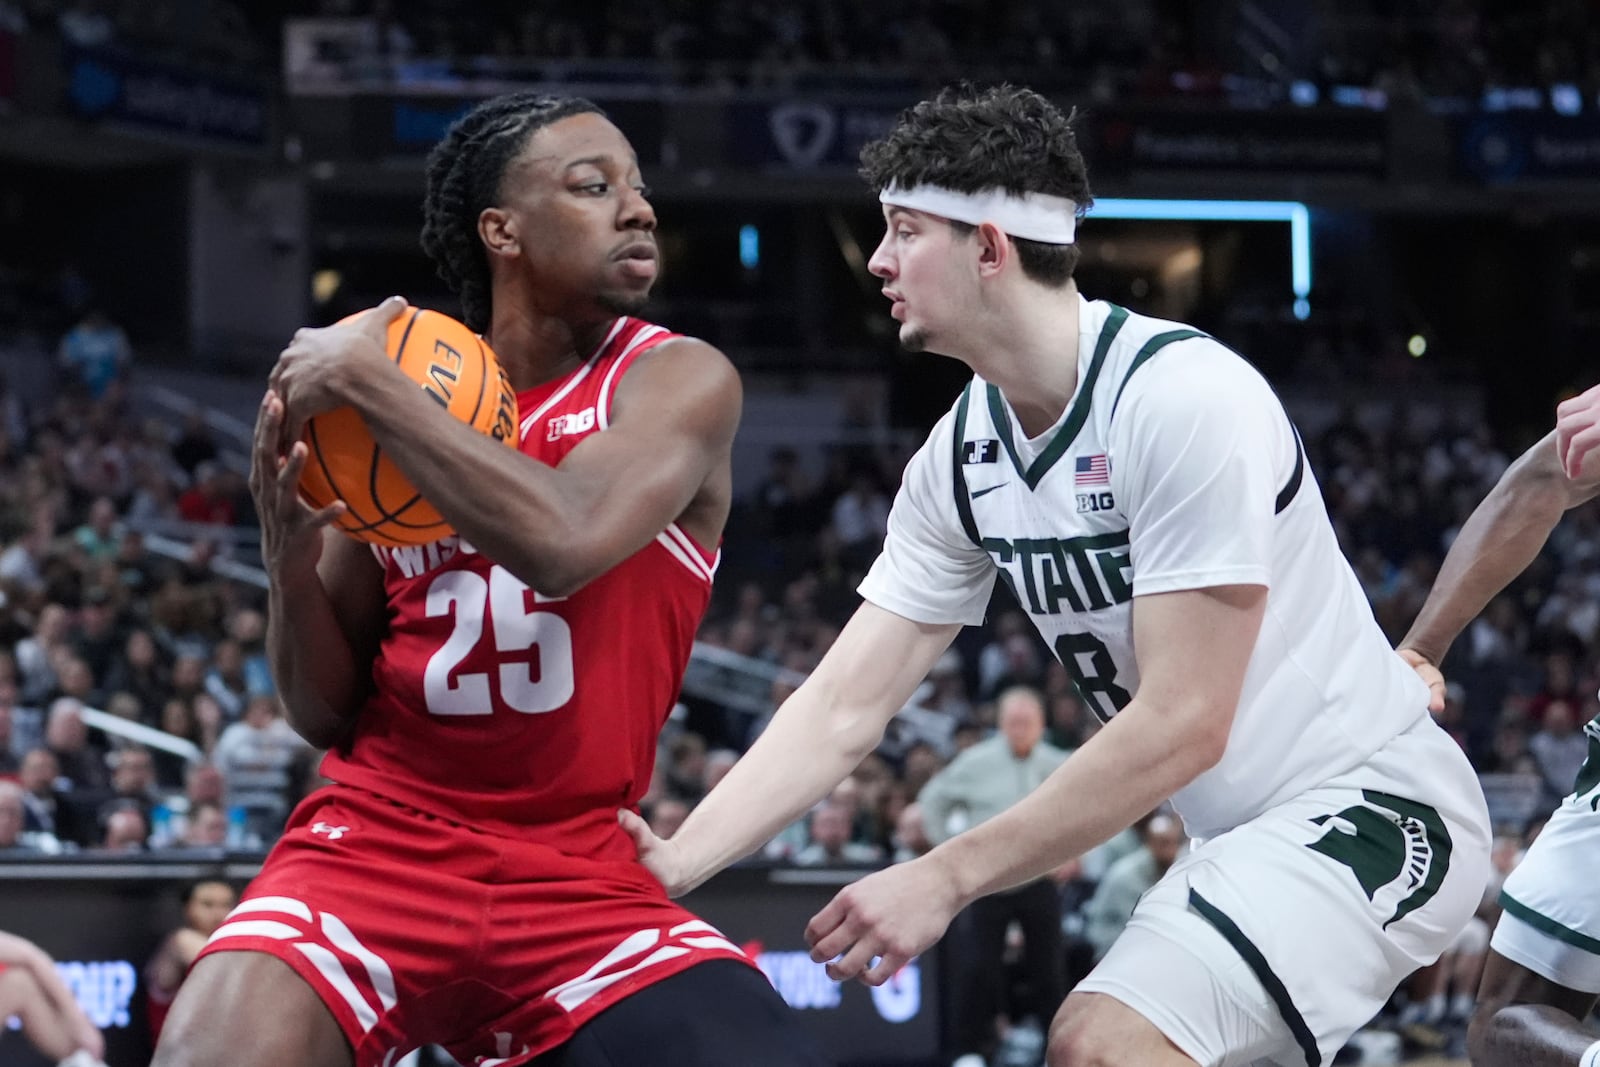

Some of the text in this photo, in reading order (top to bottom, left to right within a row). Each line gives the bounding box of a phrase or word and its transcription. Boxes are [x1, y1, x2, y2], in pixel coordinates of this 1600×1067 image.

[968, 439, 990, 464] JF
[981, 527, 1133, 615] STATE
[423, 564, 575, 716] 25
[1055, 632, 1132, 723] 8
